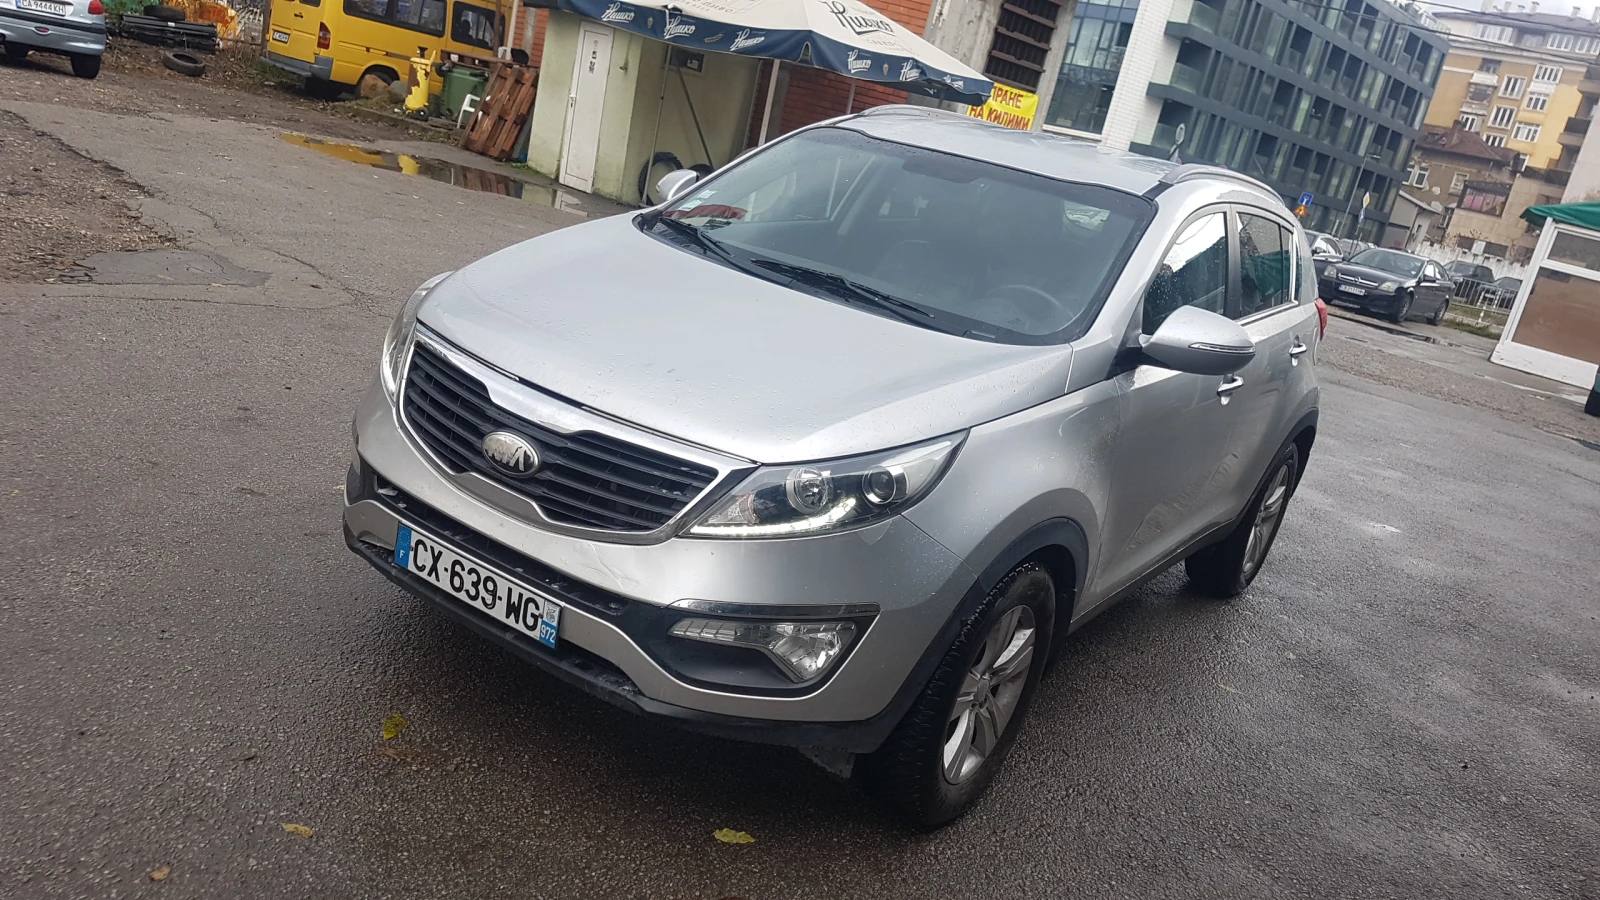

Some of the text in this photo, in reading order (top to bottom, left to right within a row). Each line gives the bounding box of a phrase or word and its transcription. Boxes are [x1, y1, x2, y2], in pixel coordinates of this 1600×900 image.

[969, 104, 984, 119] НА
[399, 549, 405, 559] F
[412, 538, 543, 632] CX-639-WG
[540, 623, 556, 643] 972
